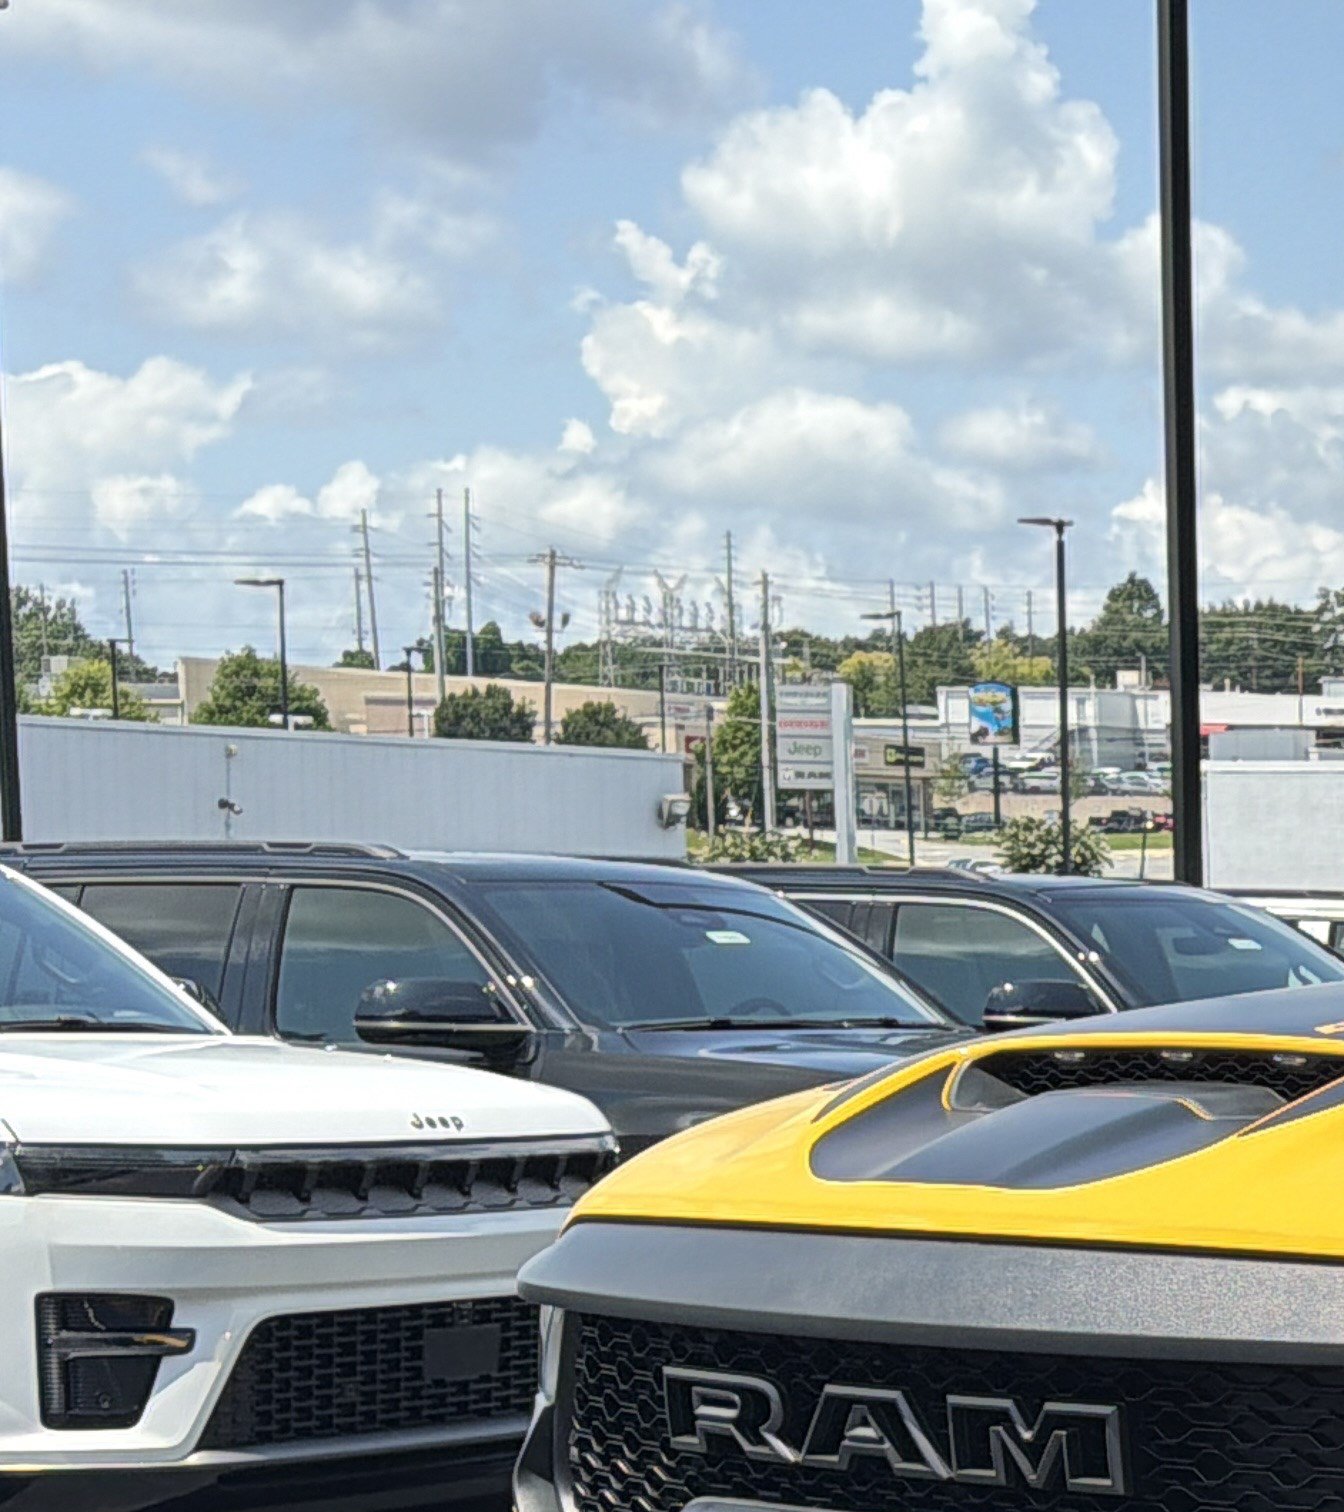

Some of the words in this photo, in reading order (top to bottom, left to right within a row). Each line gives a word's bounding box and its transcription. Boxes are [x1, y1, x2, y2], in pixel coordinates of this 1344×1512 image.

[788, 741, 823, 757] Jeep
[410, 1112, 464, 1133] Jeep
[662, 1365, 1126, 1495] RAM
